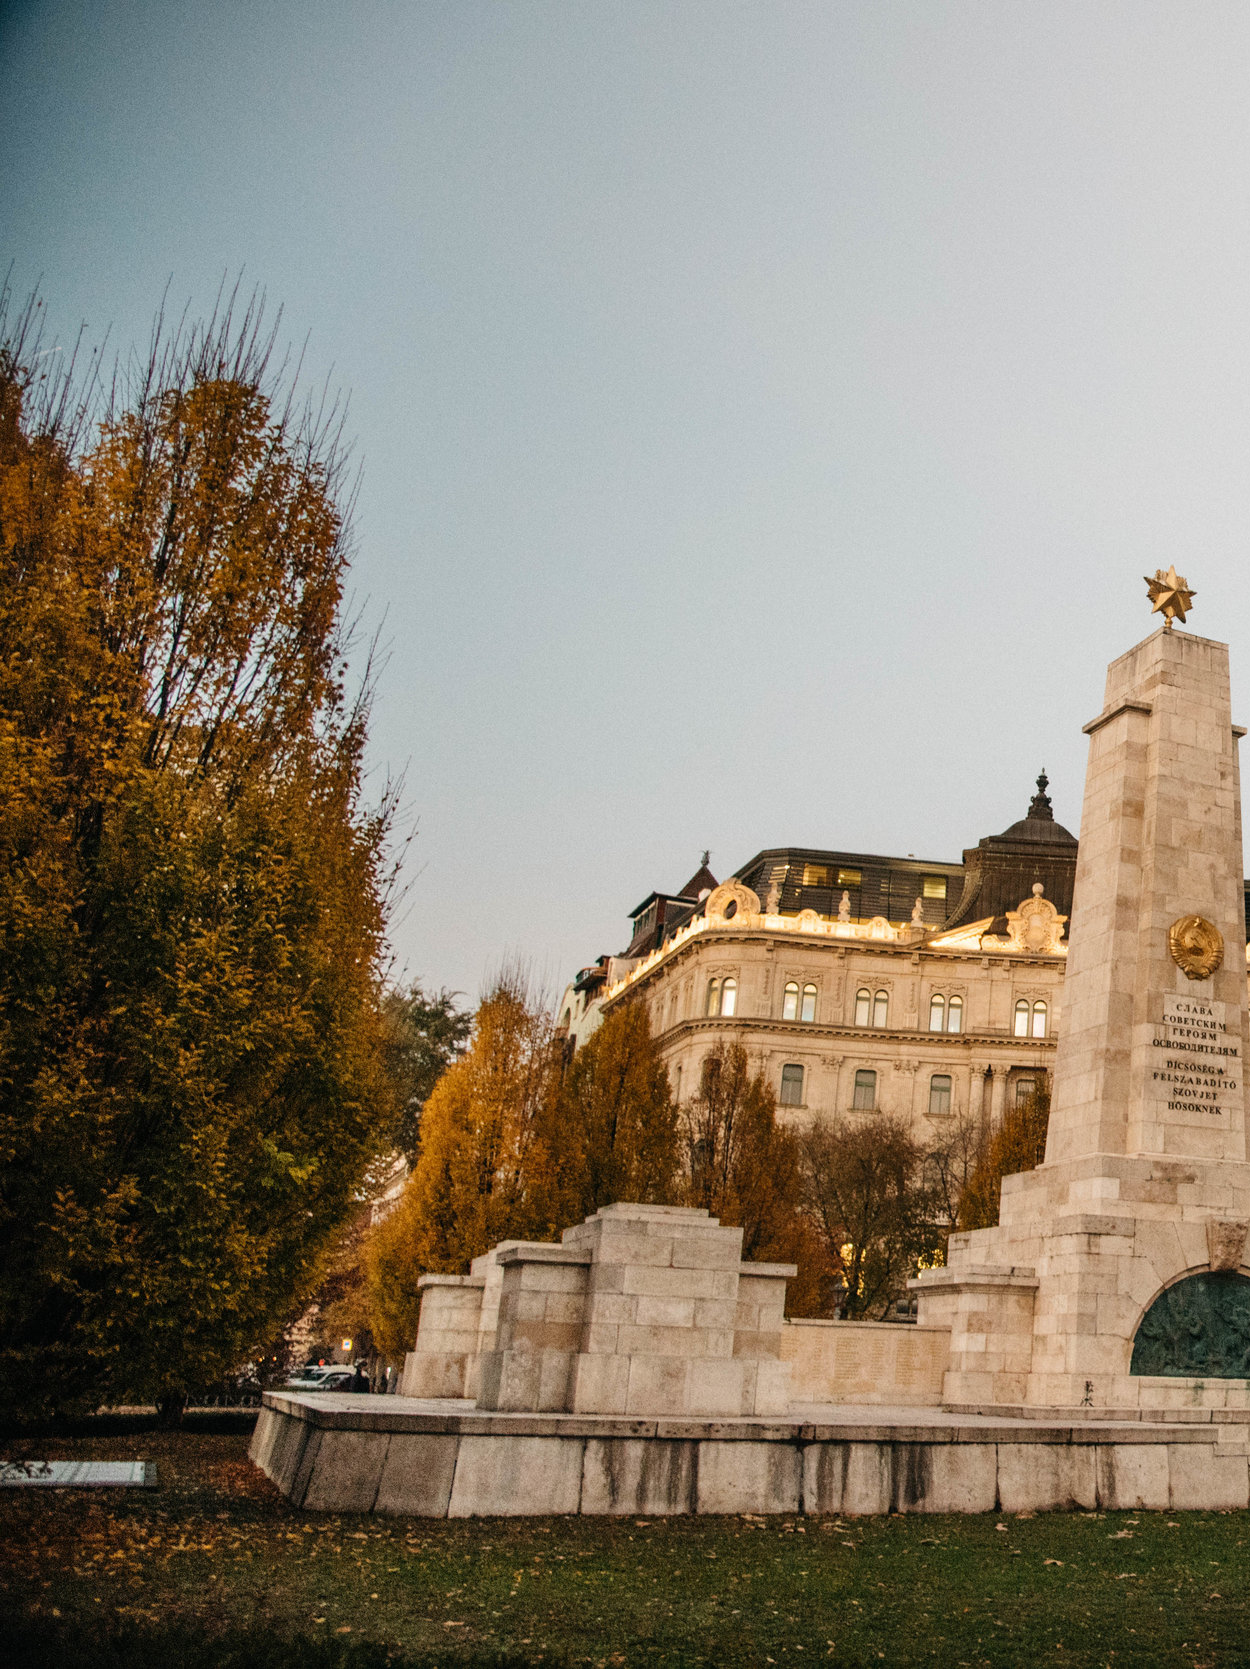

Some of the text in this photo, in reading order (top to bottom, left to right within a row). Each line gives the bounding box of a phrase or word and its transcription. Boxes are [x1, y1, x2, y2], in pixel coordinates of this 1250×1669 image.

[1176, 1003, 1213, 1016] СЛАВА
[1162, 1014, 1226, 1032] СОВЕТСКИМ
[1173, 1027, 1217, 1041] ГЕРОЯМ
[1153, 1039, 1237, 1056] ОСВОБОДИТЕЛЯМ
[1153, 1072, 1237, 1090] FELSZABADÍTÓ
[1173, 1086, 1218, 1101] SZOVJET
